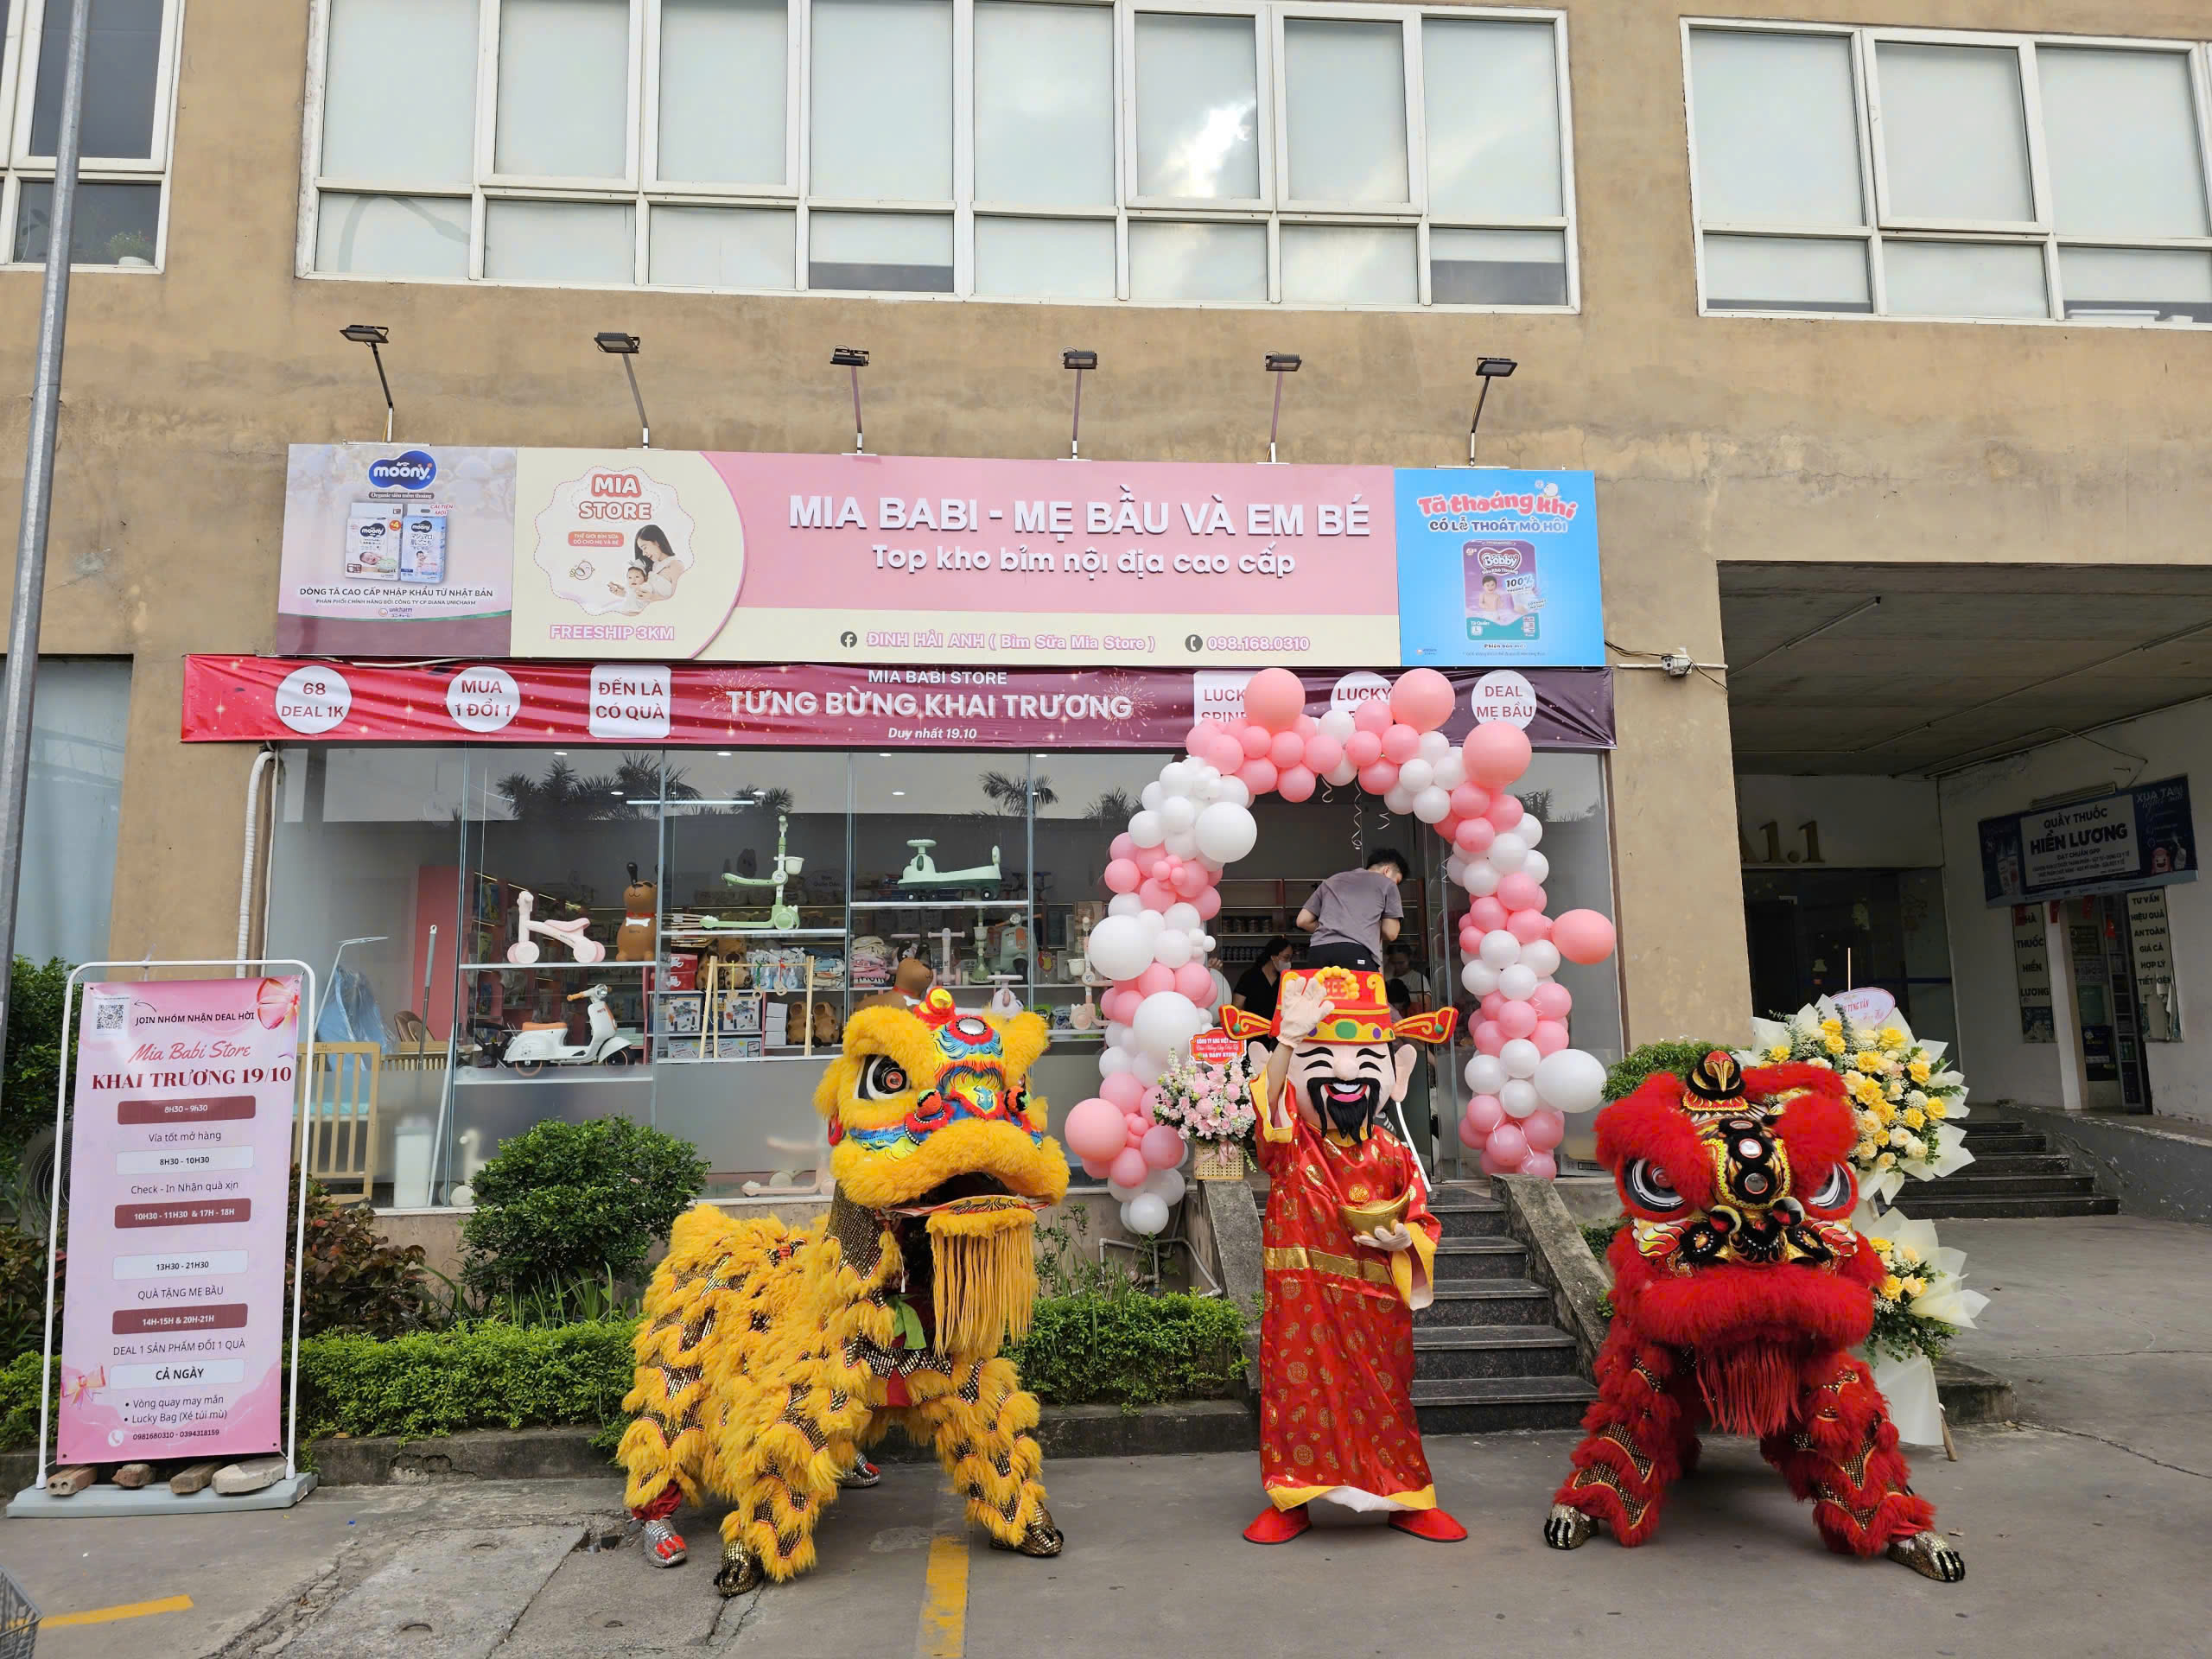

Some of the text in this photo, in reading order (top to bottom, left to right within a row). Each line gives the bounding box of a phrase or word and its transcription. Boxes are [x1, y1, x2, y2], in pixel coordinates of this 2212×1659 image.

[373, 463, 432, 480] moony
[593, 475, 640, 496] MIA
[579, 500, 652, 520] STORE
[790, 495, 867, 529] MIA
[879, 497, 978, 531] BABI
[1014, 500, 1073, 543] MẸ
[1086, 484, 1168, 535] BẦU
[1181, 494, 1236, 536] VÀ
[1247, 504, 1304, 536] EM
[1317, 493, 1370, 537] BÉ
[1418, 492, 1578, 520] Tã thoáng khí
[1429, 518, 1448, 531] CÓ
[1471, 518, 1516, 531] THOÁT
[1520, 518, 1540, 531] MỒ
[1543, 518, 1567, 532] HÔI
[873, 544, 928, 574] Top
[937, 545, 991, 570] kho
[1064, 546, 1108, 581] nội
[1117, 549, 1164, 579] địa
[1173, 554, 1230, 574] cao
[1238, 541, 1296, 578] cấp
[1482, 553, 1519, 568] Bobby
[1506, 575, 1533, 588] 100%
[300, 586, 327, 595] DÒNG
[328, 587, 340, 595] TÃ
[364, 587, 381, 595] CẤP
[383, 588, 407, 597] NHẬP
[410, 586, 434, 596] KHẨU
[435, 588, 448, 596] TỪ
[449, 588, 473, 598] NHẬT
[475, 588, 493, 596] BẢN
[550, 625, 675, 641] FREESHIP 3KM
[867, 632, 908, 648] ĐINH
[913, 629, 944, 648] HẢI
[947, 632, 985, 648] ANH
[1035, 633, 1066, 650] Sữa
[1071, 634, 1099, 650] Mia
[1103, 635, 1146, 651] Store
[1206, 635, 1311, 651] 098.168.0310
[868, 669, 1007, 685] MIA BABI STORE
[303, 683, 327, 696] 68
[461, 680, 503, 694] MUA
[598, 677, 664, 696] ĐẾN LÀ
[1484, 685, 1523, 698] DEAL
[726, 685, 1134, 719] TƯNG BỪNG KHAI TRƯƠNG
[1204, 689, 1244, 702] LUCK
[1337, 688, 1392, 701] LUCKY
[281, 706, 344, 717] DEAL 1K
[454, 698, 512, 717] 1 ĐỔI 1
[595, 702, 664, 721] CÓ QUÀ
[1476, 702, 1533, 721] MẸ BẦU
[888, 726, 977, 741] Duy nhất 19.10
[2044, 804, 2107, 829] QUẦY THUỐC
[2030, 823, 2128, 855] HIỀN LƯƠNG
[2144, 892, 2160, 904] VẤN
[2148, 909, 2165, 920] QUẢ
[2134, 929, 2145, 938] AN
[2016, 934, 2044, 949] THUỐC
[135, 1010, 255, 1027] JOIN NHÓM NHẬN DEAL HỜI
[128, 1040, 251, 1064] Mia Babi Store
[92, 1065, 291, 1090] KHAI TRƯƠNG 19/10
[149, 1130, 221, 1142] Vía tốt mở hàng
[160, 1156, 210, 1166] 8H30 10H30
[130, 1180, 238, 1194] Check In Nhận quà xịn
[134, 1212, 158, 1221] 10H30
[164, 1211, 188, 1219] 11H30
[156, 1262, 180, 1271] 13H30
[137, 1284, 224, 1300] QUÀ TẶNG MẸ BẦU
[142, 1316, 174, 1325] 14H-15H
[183, 1314, 214, 1324] 20H-21H
[113, 1346, 137, 1355] DEAL
[147, 1342, 165, 1353] SẢN
[168, 1340, 195, 1352] PHẨM
[225, 1338, 245, 1350] QUÀ
[156, 1366, 204, 1380] CẢ NGÀY
[133, 1399, 156, 1410] Vòng
[158, 1398, 181, 1409] quay
[182, 1397, 201, 1408] may
[131, 1408, 227, 1426] Lucky Bag (Xé túi mù)
[133, 1428, 219, 1440] 0981680310 0394318159
